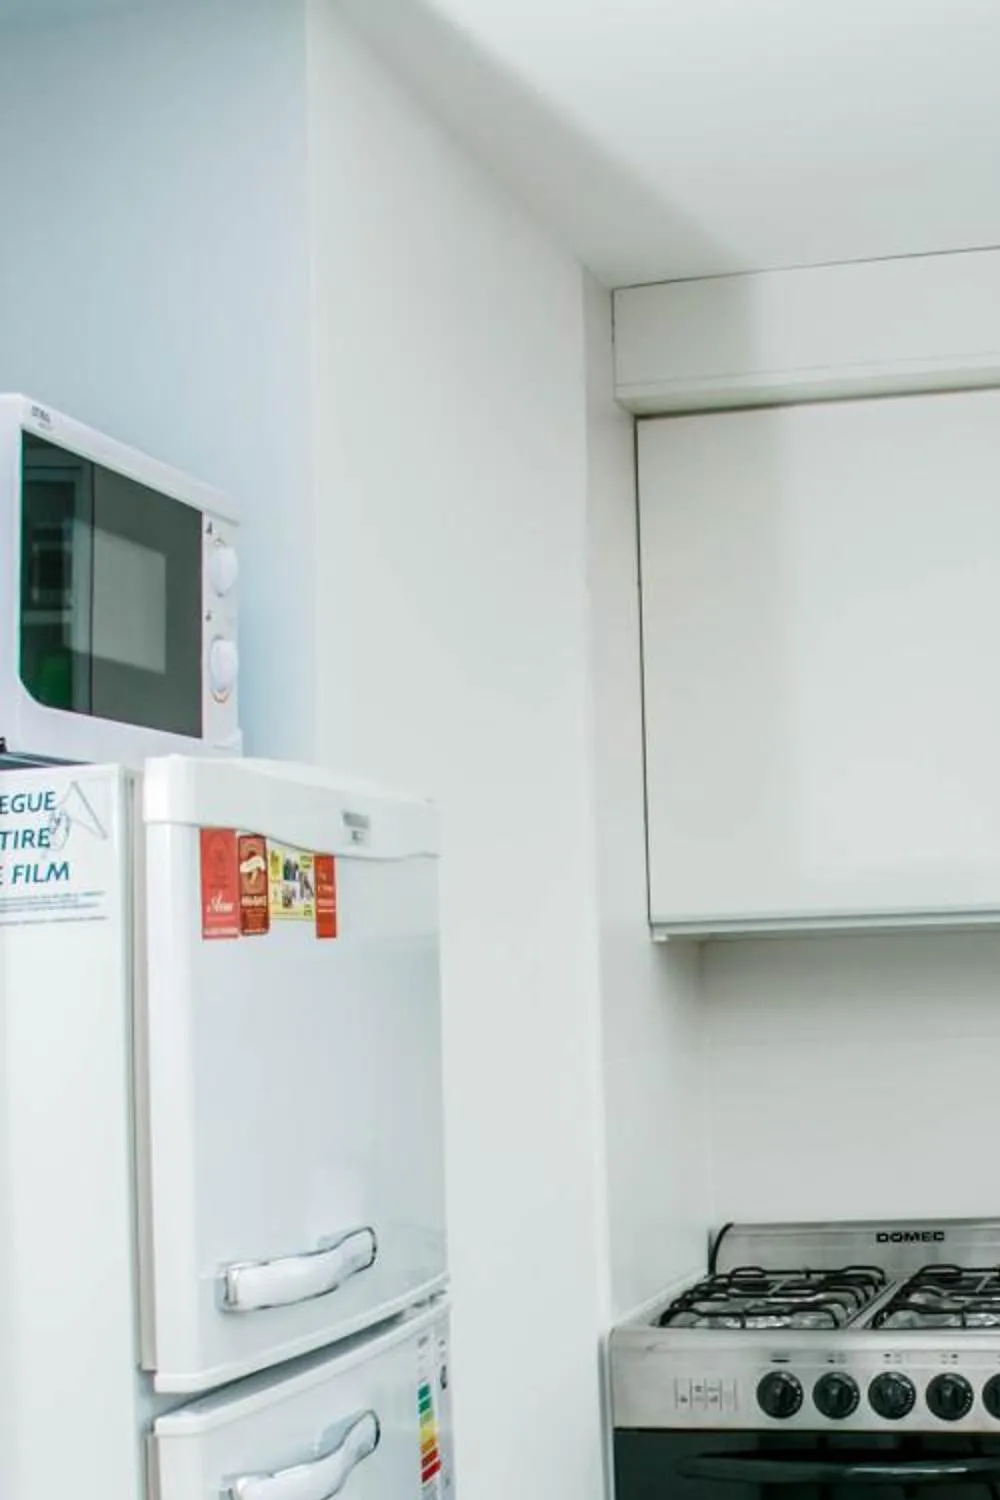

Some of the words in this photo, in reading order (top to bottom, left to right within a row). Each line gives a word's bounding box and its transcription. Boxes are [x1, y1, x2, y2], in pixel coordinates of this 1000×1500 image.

[0, 791, 56, 814] EGUE
[0, 827, 51, 850] TIRE
[12, 861, 70, 884] FILM
[876, 1232, 945, 1242] DOMEC
